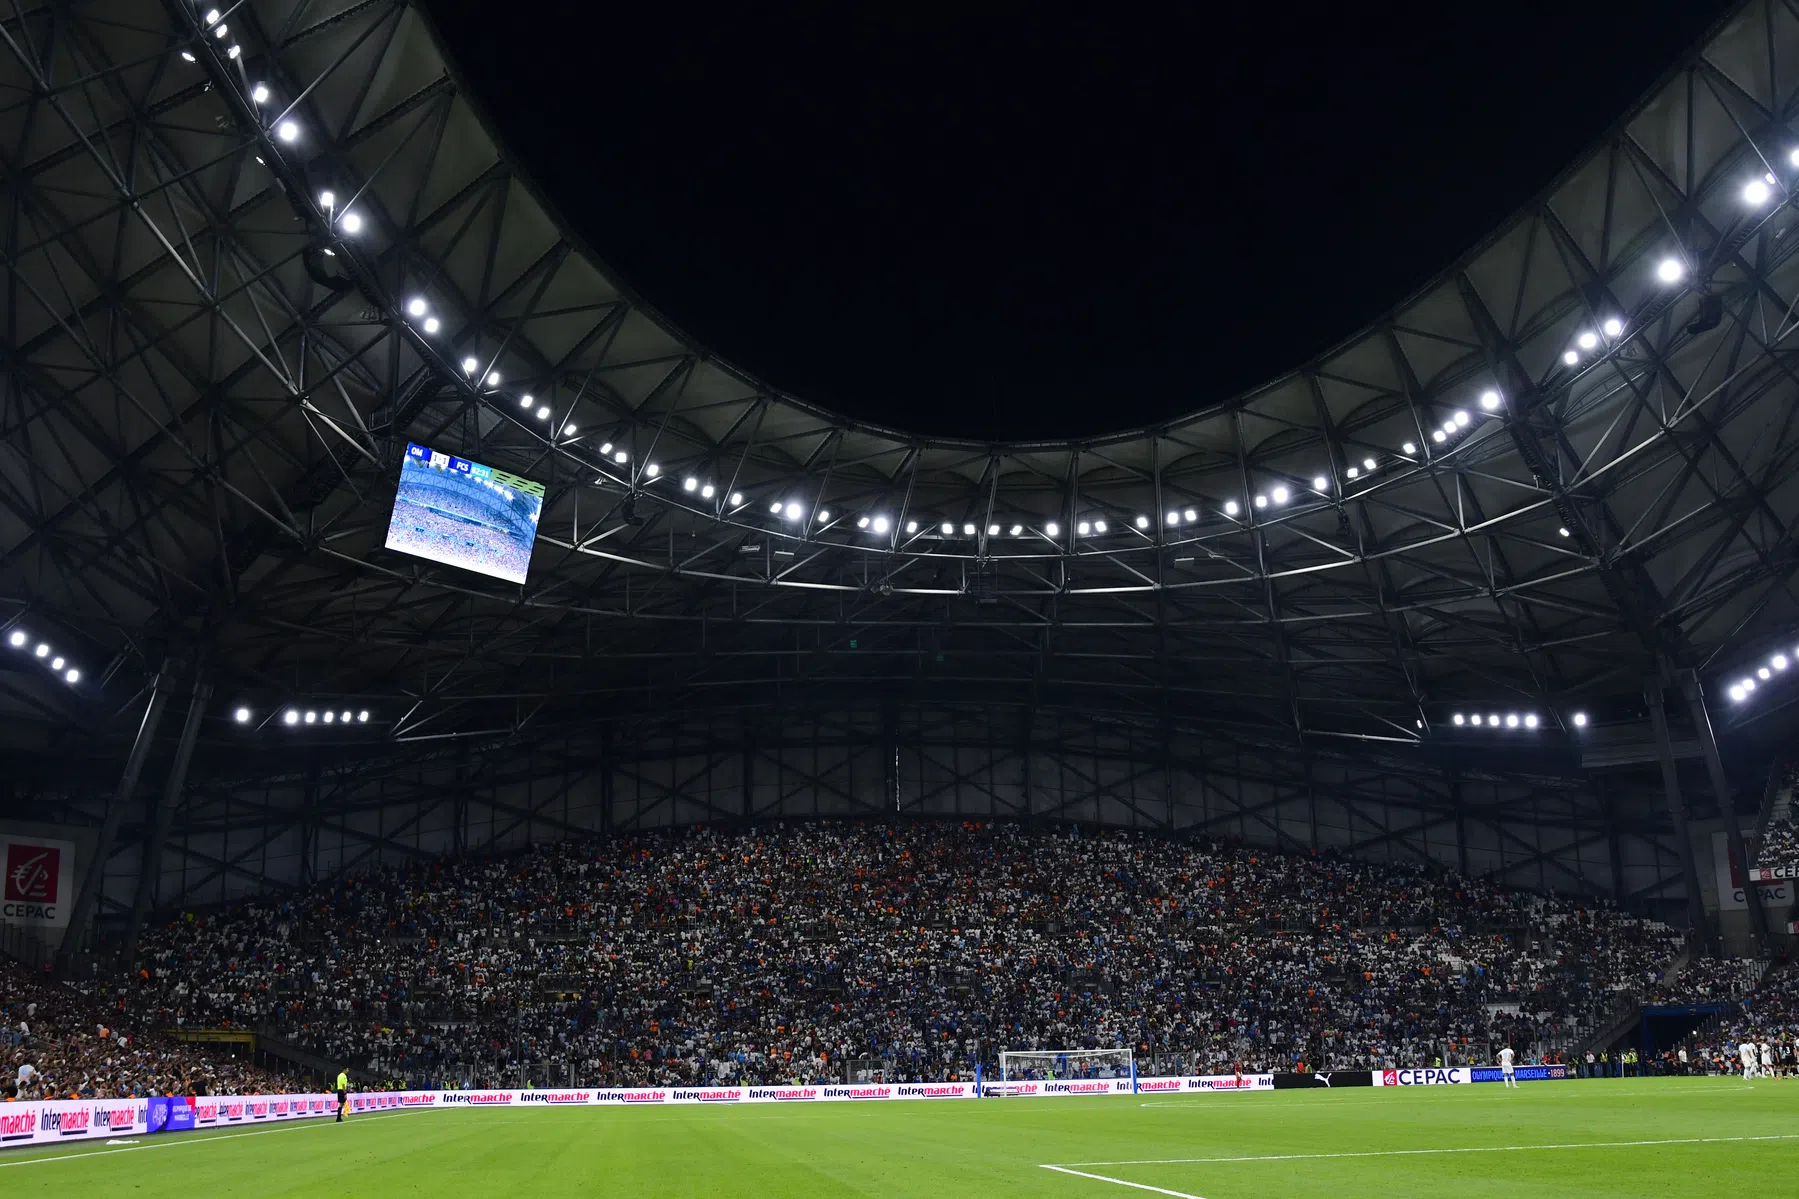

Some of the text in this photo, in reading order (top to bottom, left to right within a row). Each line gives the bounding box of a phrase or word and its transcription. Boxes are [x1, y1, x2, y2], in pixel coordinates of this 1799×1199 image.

[411, 447, 423, 457] OM
[456, 461, 469, 472] FCS
[3, 903, 56, 920] CEPAC
[1786, 1046, 1791, 1054] 3
[1398, 1068, 1461, 1086] CEPAC
[1550, 1068, 1565, 1078] 1899
[443, 1092, 512, 1105] Intermarché
[520, 1091, 589, 1103] Intermarché
[597, 1090, 665, 1102] Intermarché
[673, 1089, 741, 1101] Intermarché
[749, 1088, 817, 1100] Intermarché
[824, 1087, 890, 1099] Intermarché
[898, 1085, 964, 1098] Intermarché
[1044, 1082, 1109, 1093] Intermarché
[0, 1109, 36, 1135] marché
[41, 1107, 89, 1136] Intermarché
[94, 1105, 134, 1131] Intermarché
